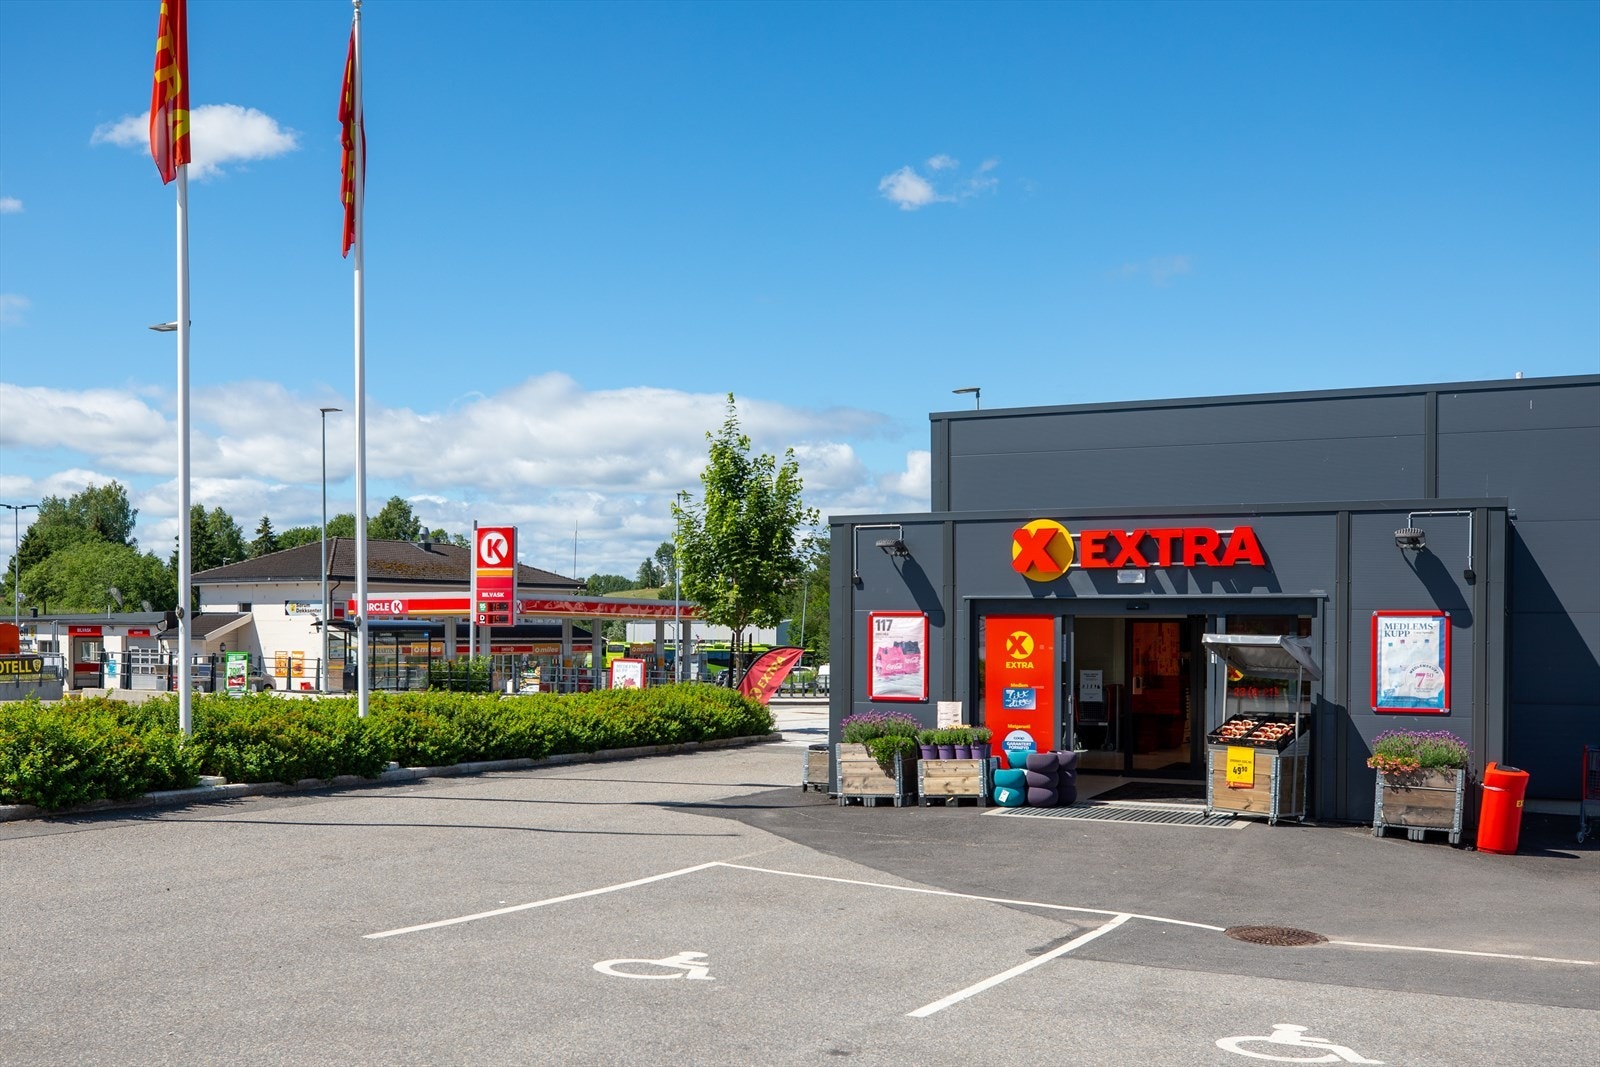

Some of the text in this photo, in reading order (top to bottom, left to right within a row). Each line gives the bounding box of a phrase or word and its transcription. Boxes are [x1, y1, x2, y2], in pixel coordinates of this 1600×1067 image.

[1080, 526, 1265, 569] EXTRA
[367, 602, 390, 611] IRCLE
[875, 618, 893, 632] 117
[1384, 622, 1437, 631] MEDLEMS-
[1384, 630, 1411, 638] KUPP
[1005, 661, 1035, 670] EXTRA
[757, 656, 786, 689] EXTRA
[1415, 673, 1426, 688] 7
